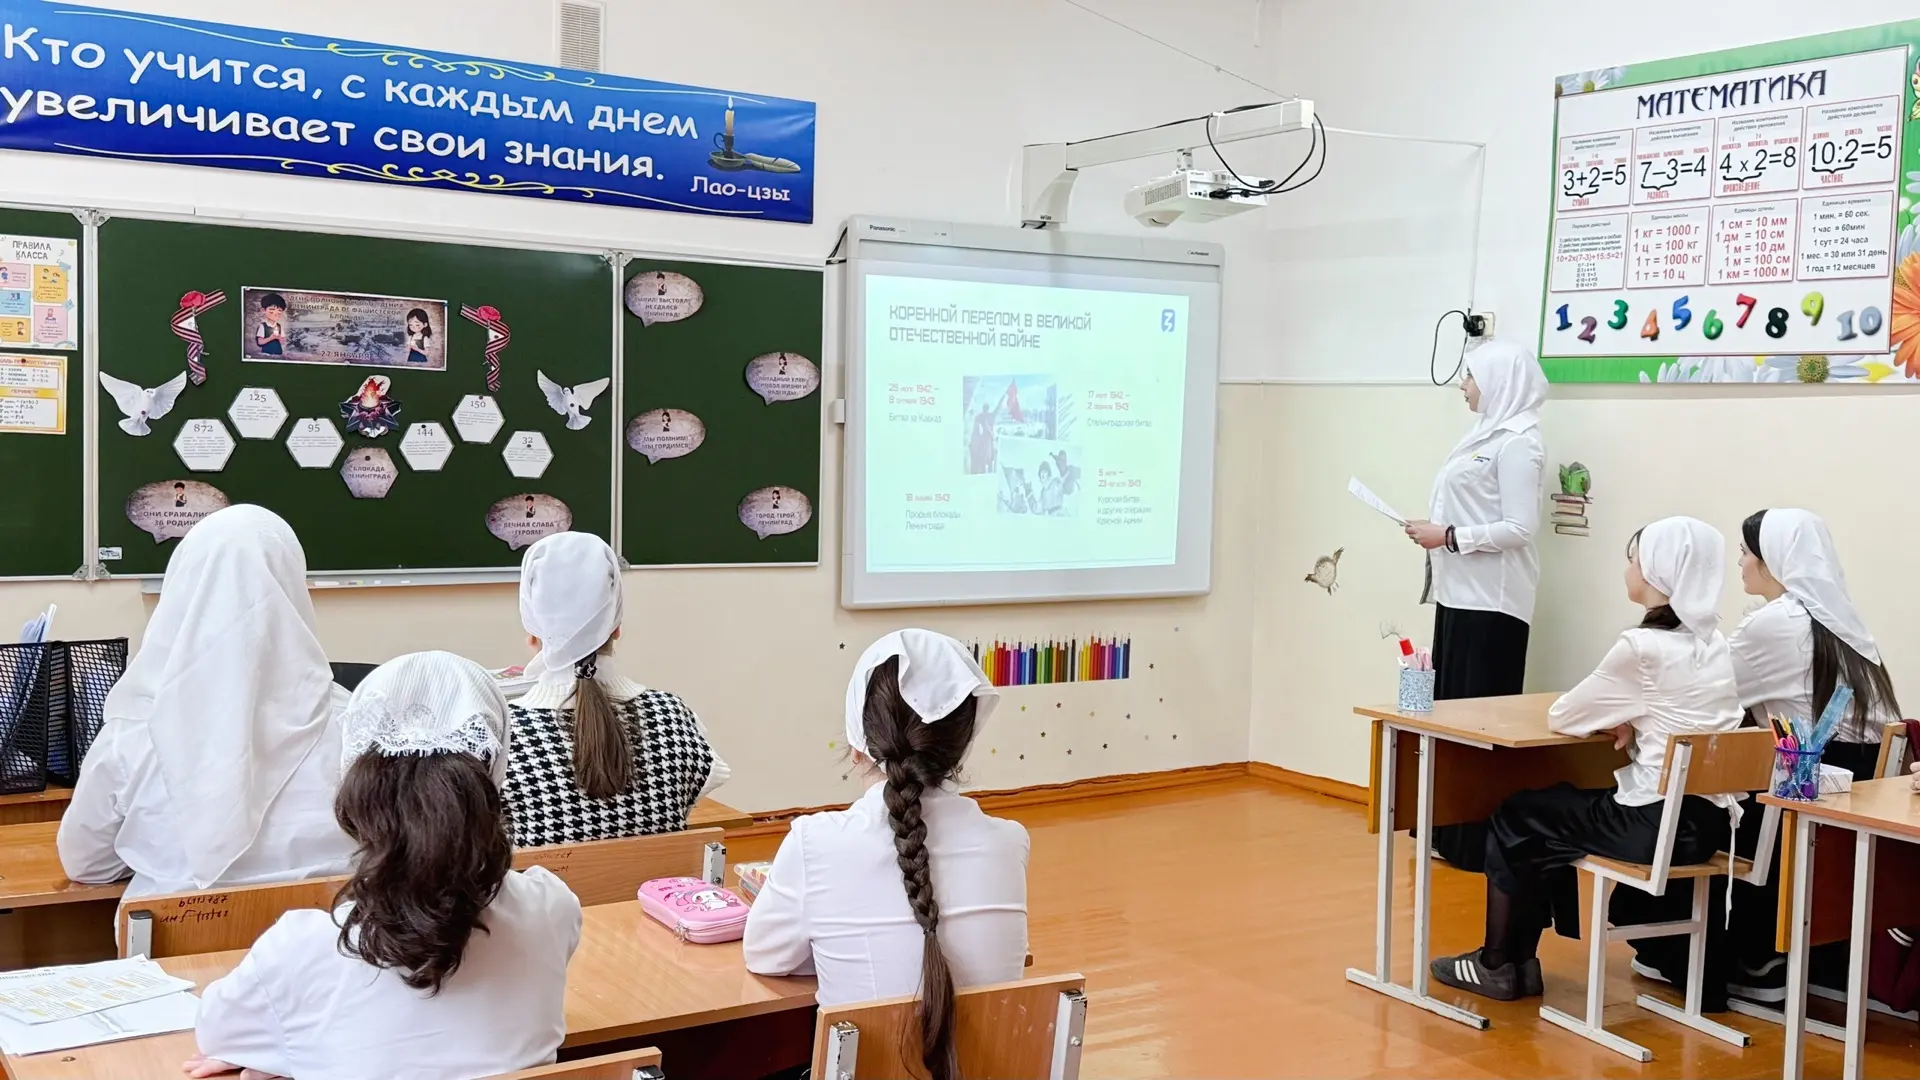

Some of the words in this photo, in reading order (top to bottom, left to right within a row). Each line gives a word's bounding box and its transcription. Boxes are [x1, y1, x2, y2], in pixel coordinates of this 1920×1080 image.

[4, 23, 106, 69] Кто
[124, 48, 324, 101] учится,
[342, 72, 366, 99] с
[384, 78, 573, 125] каждым
[588, 105, 698, 140] днем
[1636, 69, 1827, 119] МАТЕМАТИКА
[0, 86, 354, 147] увеличивает
[373, 126, 487, 161] свои
[504, 141, 665, 180] знания.
[1719, 153, 1732, 174] 4
[1754, 146, 1796, 171] 2=8
[1808, 135, 1892, 166] 10:2=5
[690, 175, 790, 202] Лао-цзы
[1563, 164, 1626, 191] 3+2=5
[869, 224, 896, 232] Panasonic
[1642, 229, 1653, 238] кг
[1666, 224, 1691, 236] 1000
[1729, 220, 1743, 229] см
[1756, 217, 1768, 227] 10
[1771, 217, 1788, 226] мм
[12, 241, 52, 251] ПРАВИЛА
[1666, 239, 1684, 251] 100
[1687, 240, 1698, 249] кг
[1723, 233, 1739, 243] дм
[1755, 229, 1767, 240] 10
[1770, 230, 1785, 239] см
[15, 250, 48, 260] КЛАССА
[1733, 245, 1742, 254] м
[1755, 242, 1767, 252] 10
[1770, 243, 1785, 252] дм
[1664, 254, 1689, 265] 1000
[1692, 254, 1703, 264] кг
[1733, 258, 1741, 266] м
[1754, 254, 1772, 265] 100
[1776, 255, 1791, 264] см
[1663, 269, 1675, 280] 10
[1726, 271, 1740, 279] км
[1753, 266, 1778, 277] 1000
[1781, 268, 1789, 276] м
[889, 304, 958, 324] КОРЕННОЙ
[961, 310, 1021, 328] ПЕРЕЛОМ
[1024, 313, 1033, 327] В
[1036, 312, 1092, 331] ВЕЛИКОЙ
[1555, 304, 1573, 331] 1
[1607, 300, 1629, 330] 3
[1672, 295, 1692, 331] 5
[1735, 293, 1757, 328] 7
[1801, 291, 1824, 326] 9
[1577, 316, 1598, 344] 2
[1641, 309, 1659, 341] 4
[1703, 309, 1723, 340] 6
[1765, 307, 1789, 339] 8
[1836, 306, 1883, 341] 10
[889, 326, 996, 347] ОТЕЧЕСТВЕННОЙ
[1000, 329, 1041, 348] ВОЙНЕ
[249, 394, 267, 403] 125
[470, 401, 487, 409] 150
[193, 424, 214, 433] 872
[308, 424, 321, 433] 95
[417, 428, 434, 437] 144
[522, 437, 533, 445] 32
